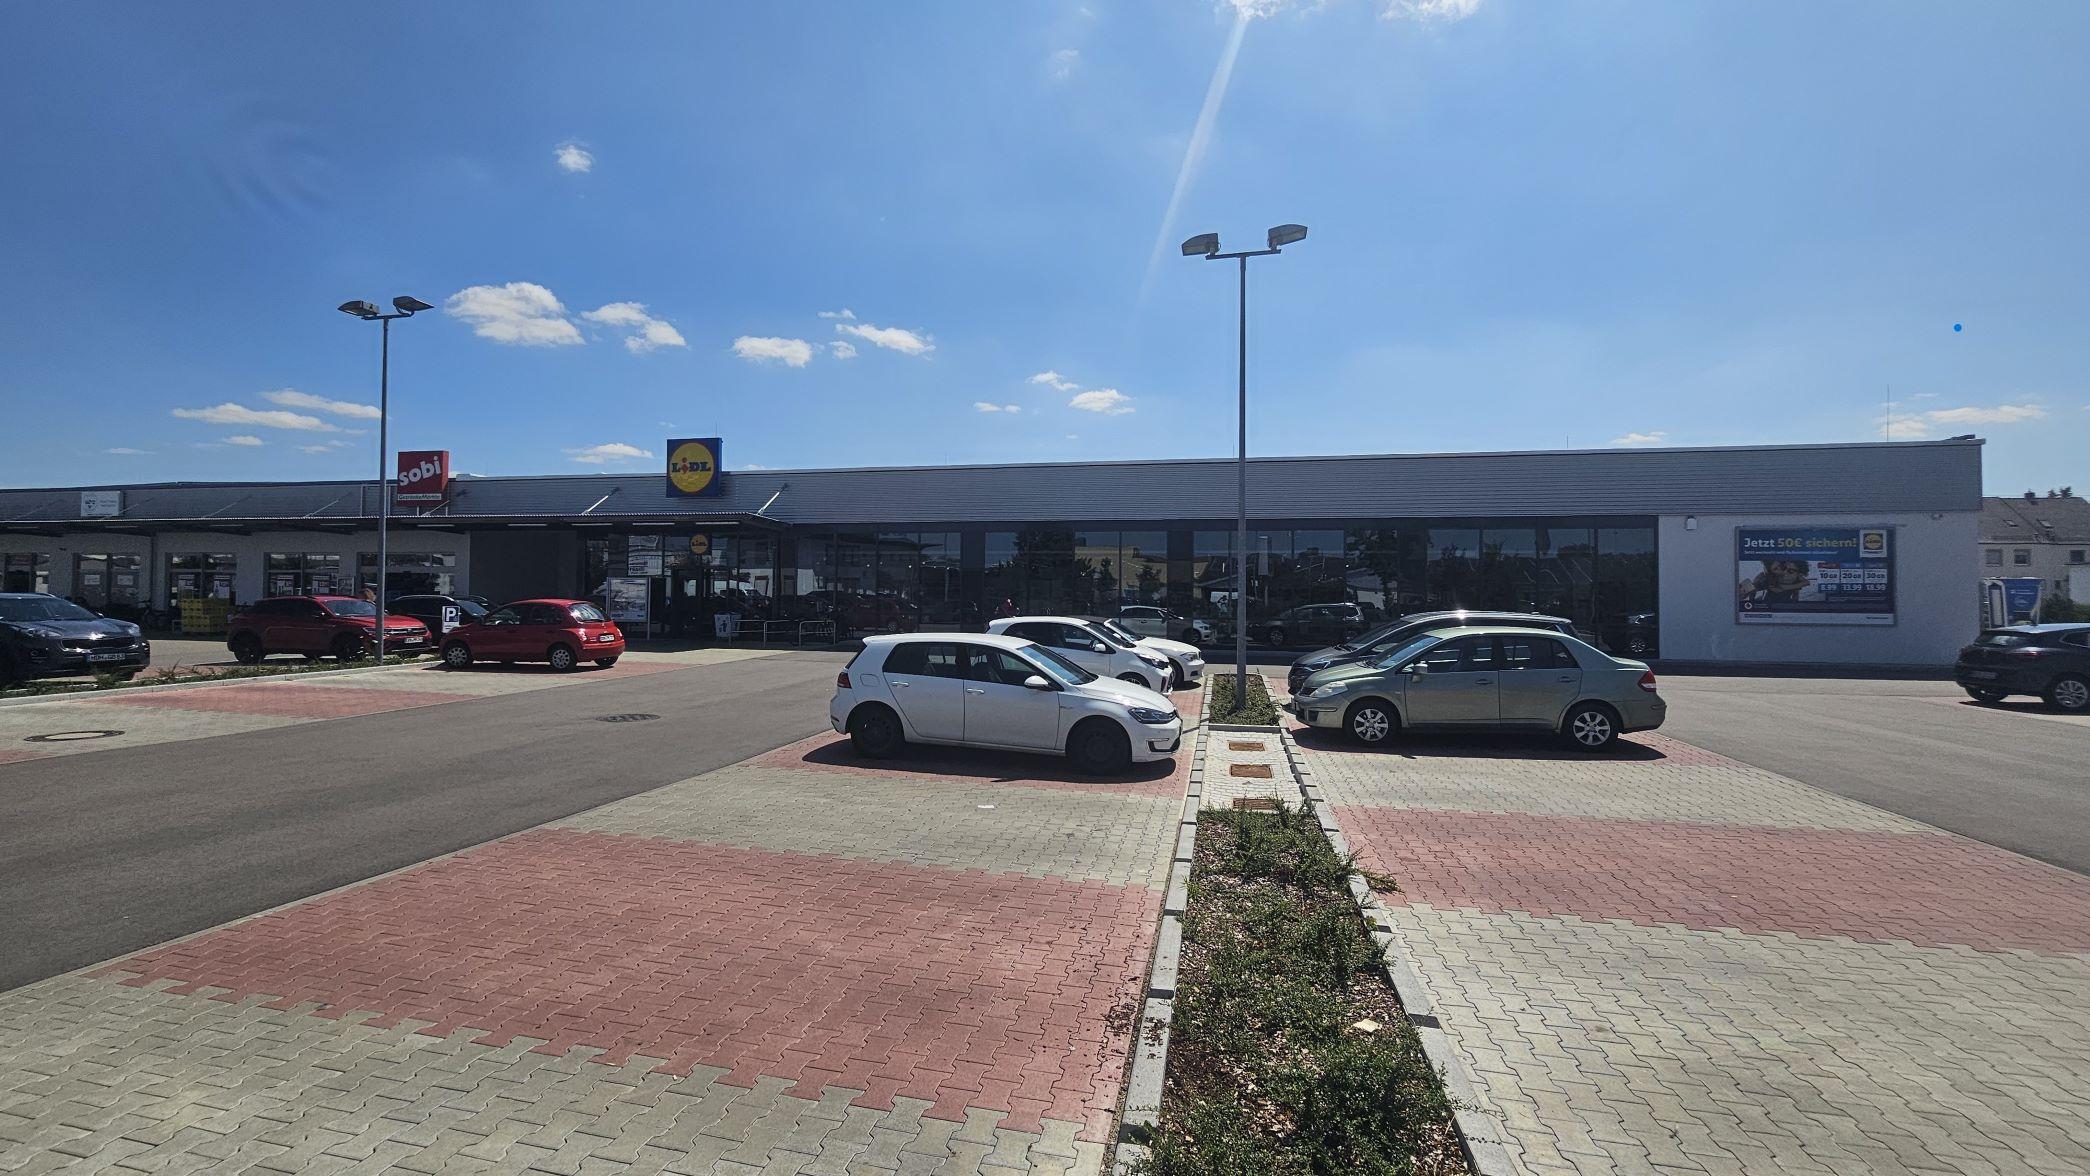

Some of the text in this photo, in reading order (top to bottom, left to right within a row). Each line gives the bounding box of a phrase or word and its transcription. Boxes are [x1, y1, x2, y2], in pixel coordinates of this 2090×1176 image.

[399, 456, 441, 486] sobi
[671, 457, 712, 474] LIDL
[1744, 537, 1857, 548] Jetzt 50€ sichern!
[445, 607, 457, 621] P
